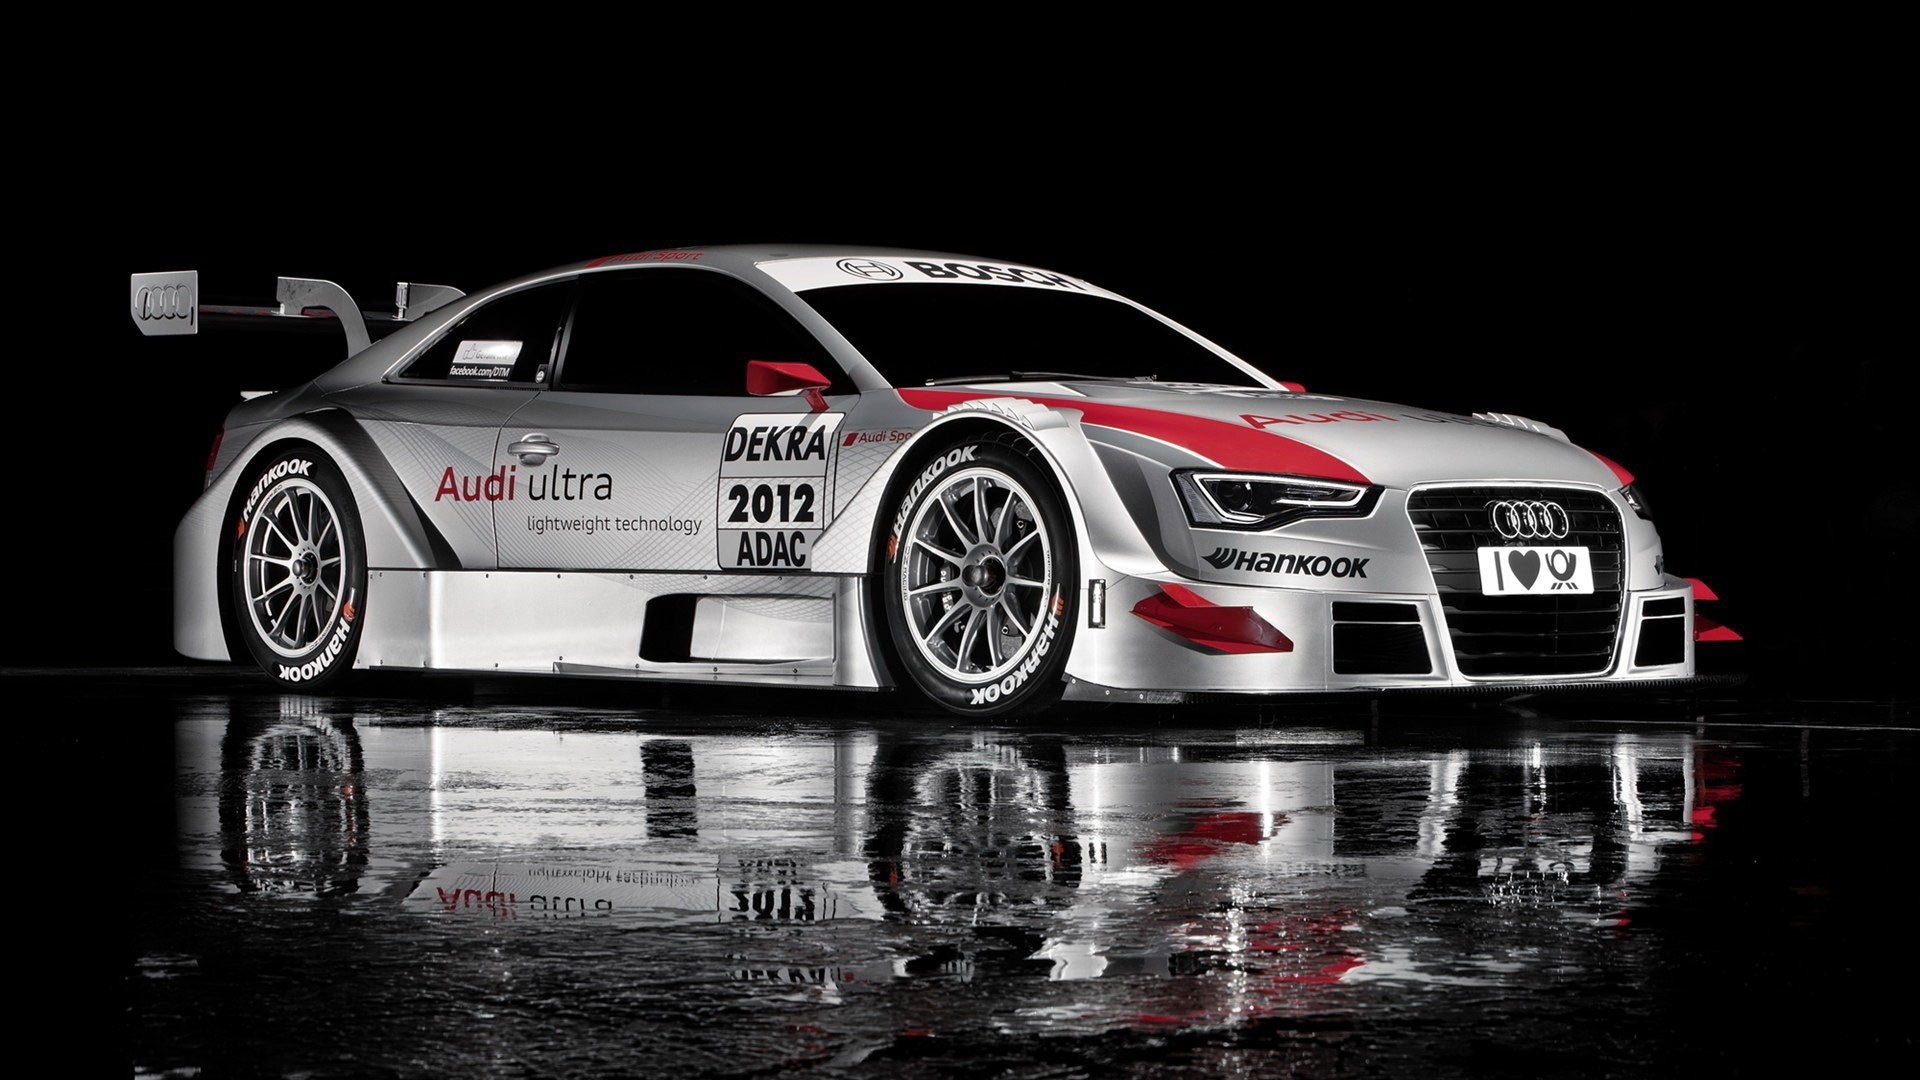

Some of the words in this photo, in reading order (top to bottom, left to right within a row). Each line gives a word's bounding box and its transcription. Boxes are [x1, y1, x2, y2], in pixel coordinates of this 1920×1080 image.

[655, 250, 703, 262] Sport
[904, 261, 1087, 291] BOSCH
[449, 365, 511, 378] facebook.com/DTM
[1239, 410, 1397, 430] Audi
[724, 424, 826, 462] DEKRA
[858, 431, 887, 444] Audi
[889, 430, 913, 443] Spo
[434, 465, 517, 502] Audi
[527, 464, 613, 501] ultra
[728, 483, 815, 523] 2012
[527, 516, 611, 535] lightweight
[615, 516, 703, 536] technology
[737, 530, 806, 567] ADAC
[1493, 551, 1504, 591] I
